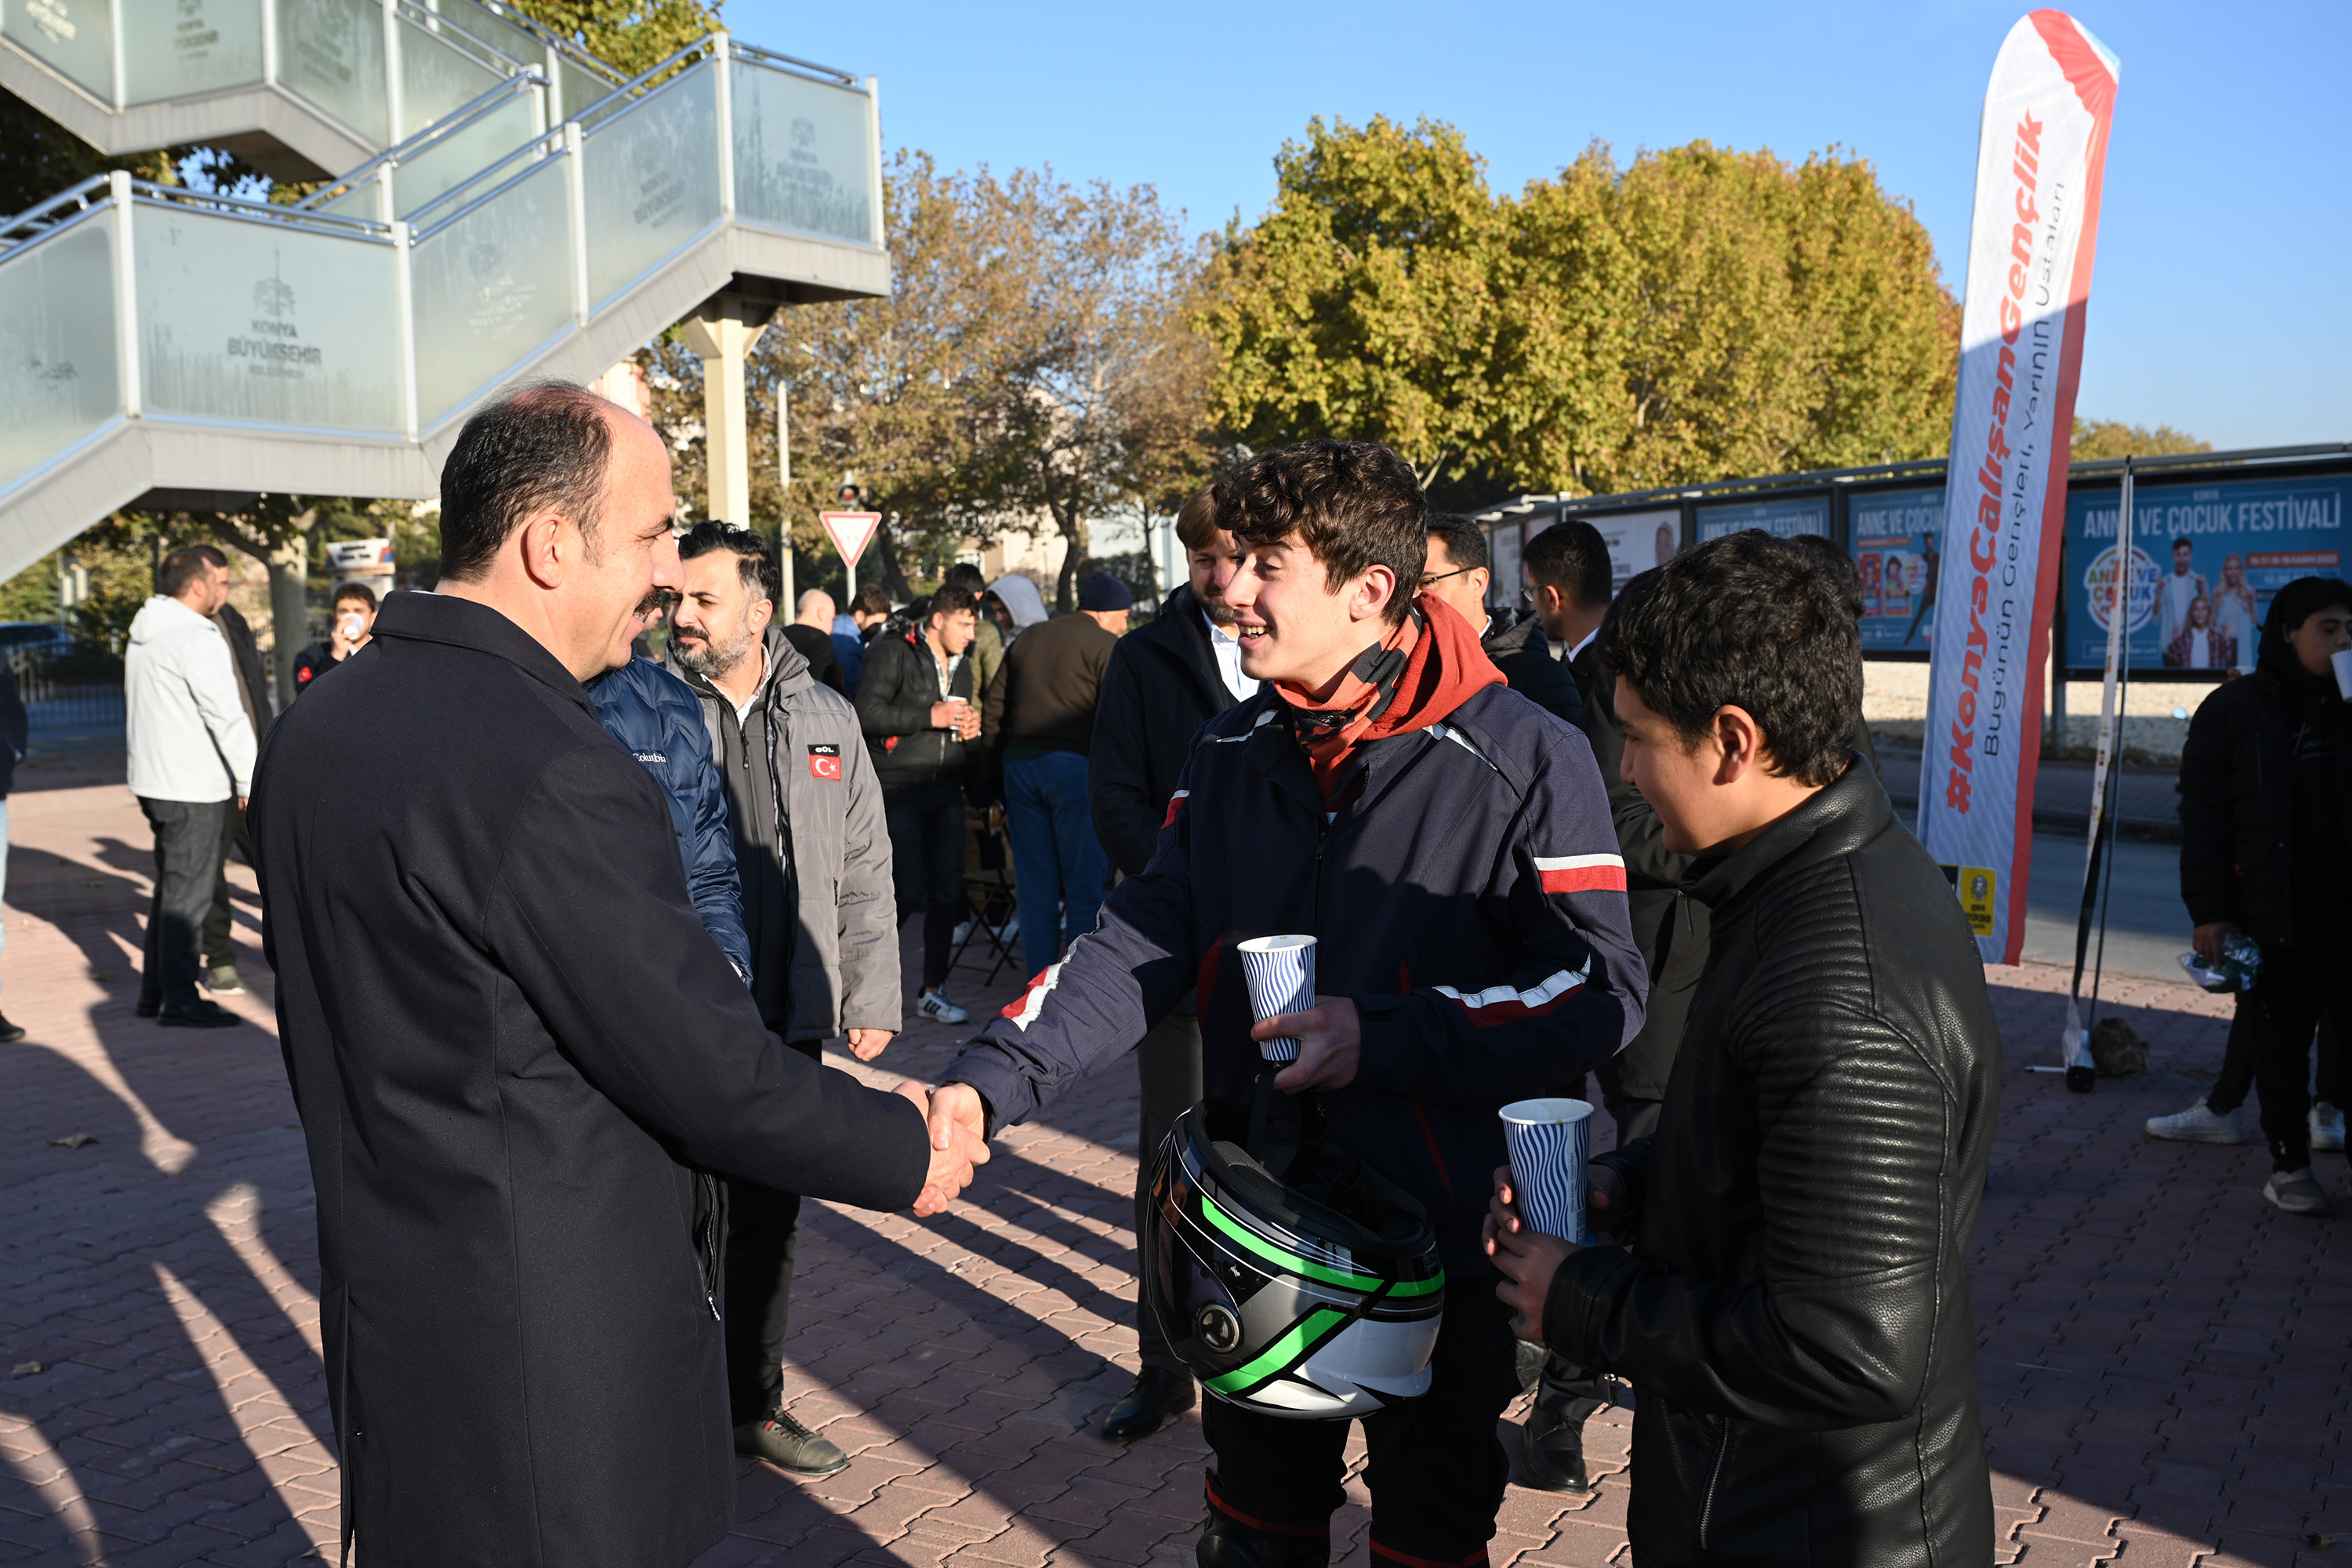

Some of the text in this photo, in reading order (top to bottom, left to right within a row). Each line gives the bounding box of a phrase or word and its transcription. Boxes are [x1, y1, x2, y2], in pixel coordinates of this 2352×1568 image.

[1947, 107, 2043, 815] #KonyaÇalışanGençlik
[1984, 182, 2065, 757] Bugünün Gençleri, Yarının Ustaları
[2083, 492, 2341, 540] ANN VE ÇOCUK FESTİVALİ
